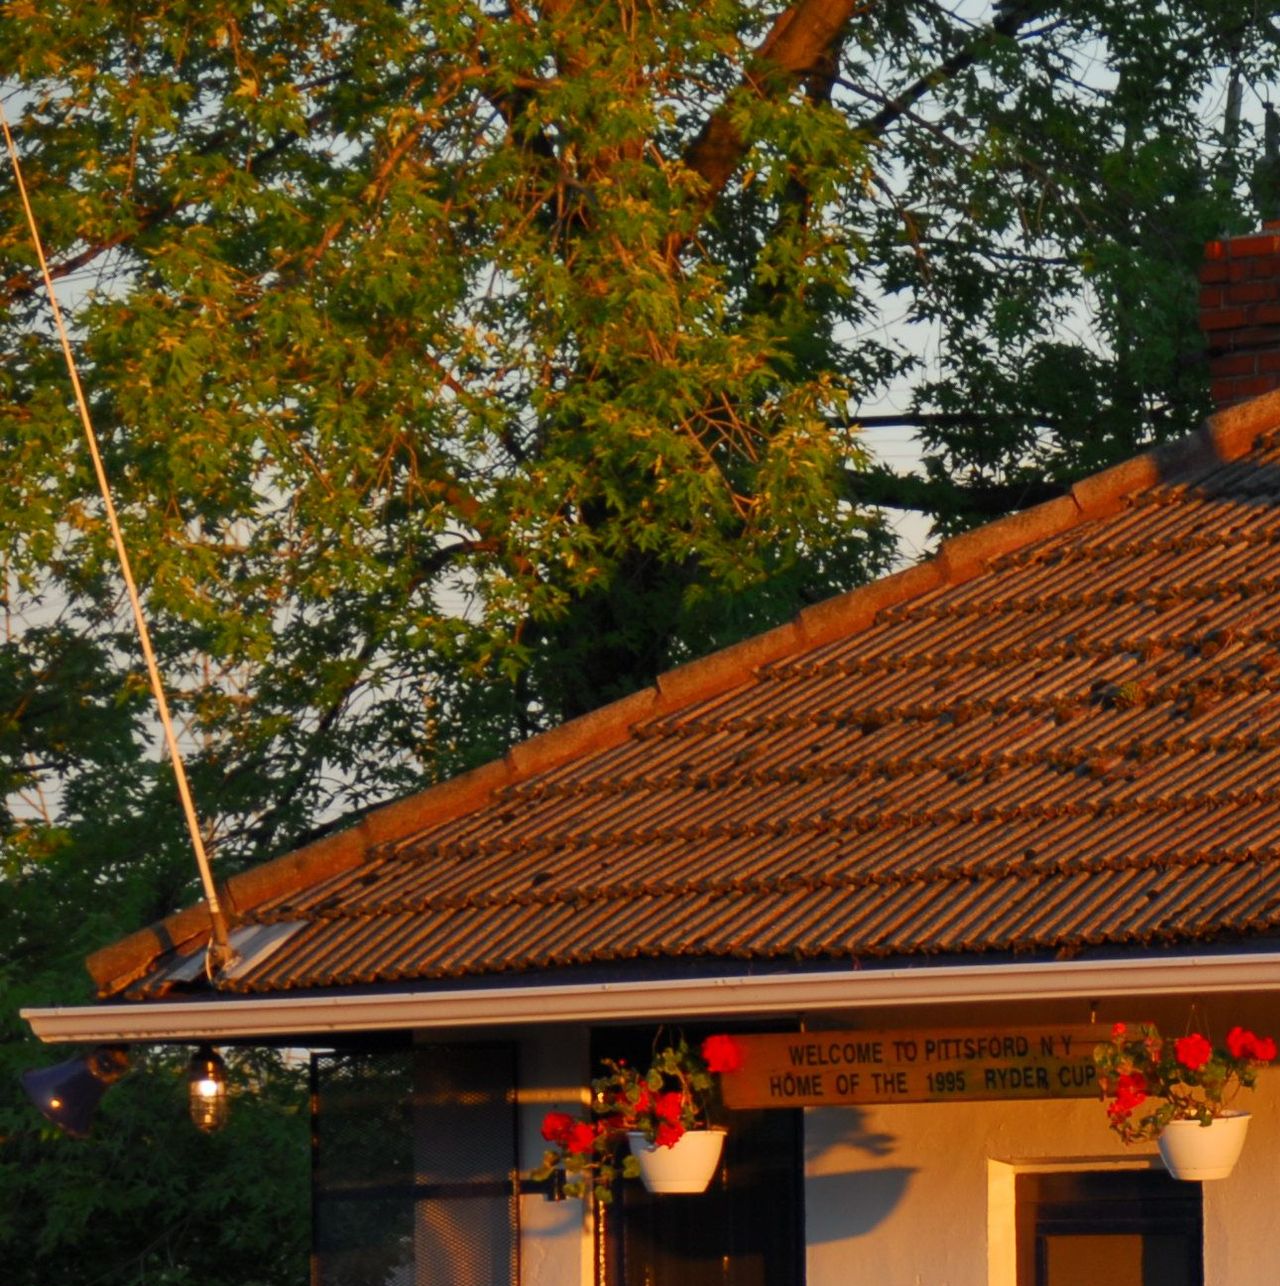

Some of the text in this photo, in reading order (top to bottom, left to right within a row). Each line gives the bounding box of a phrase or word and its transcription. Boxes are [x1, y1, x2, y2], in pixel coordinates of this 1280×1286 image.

[789, 1042, 883, 1067] WELCOME
[893, 1040, 917, 1062] TO
[925, 1036, 1028, 1061] PITTSFORD
[770, 1064, 1096, 1097] HOME OF THE 1995 RYDER CUP
